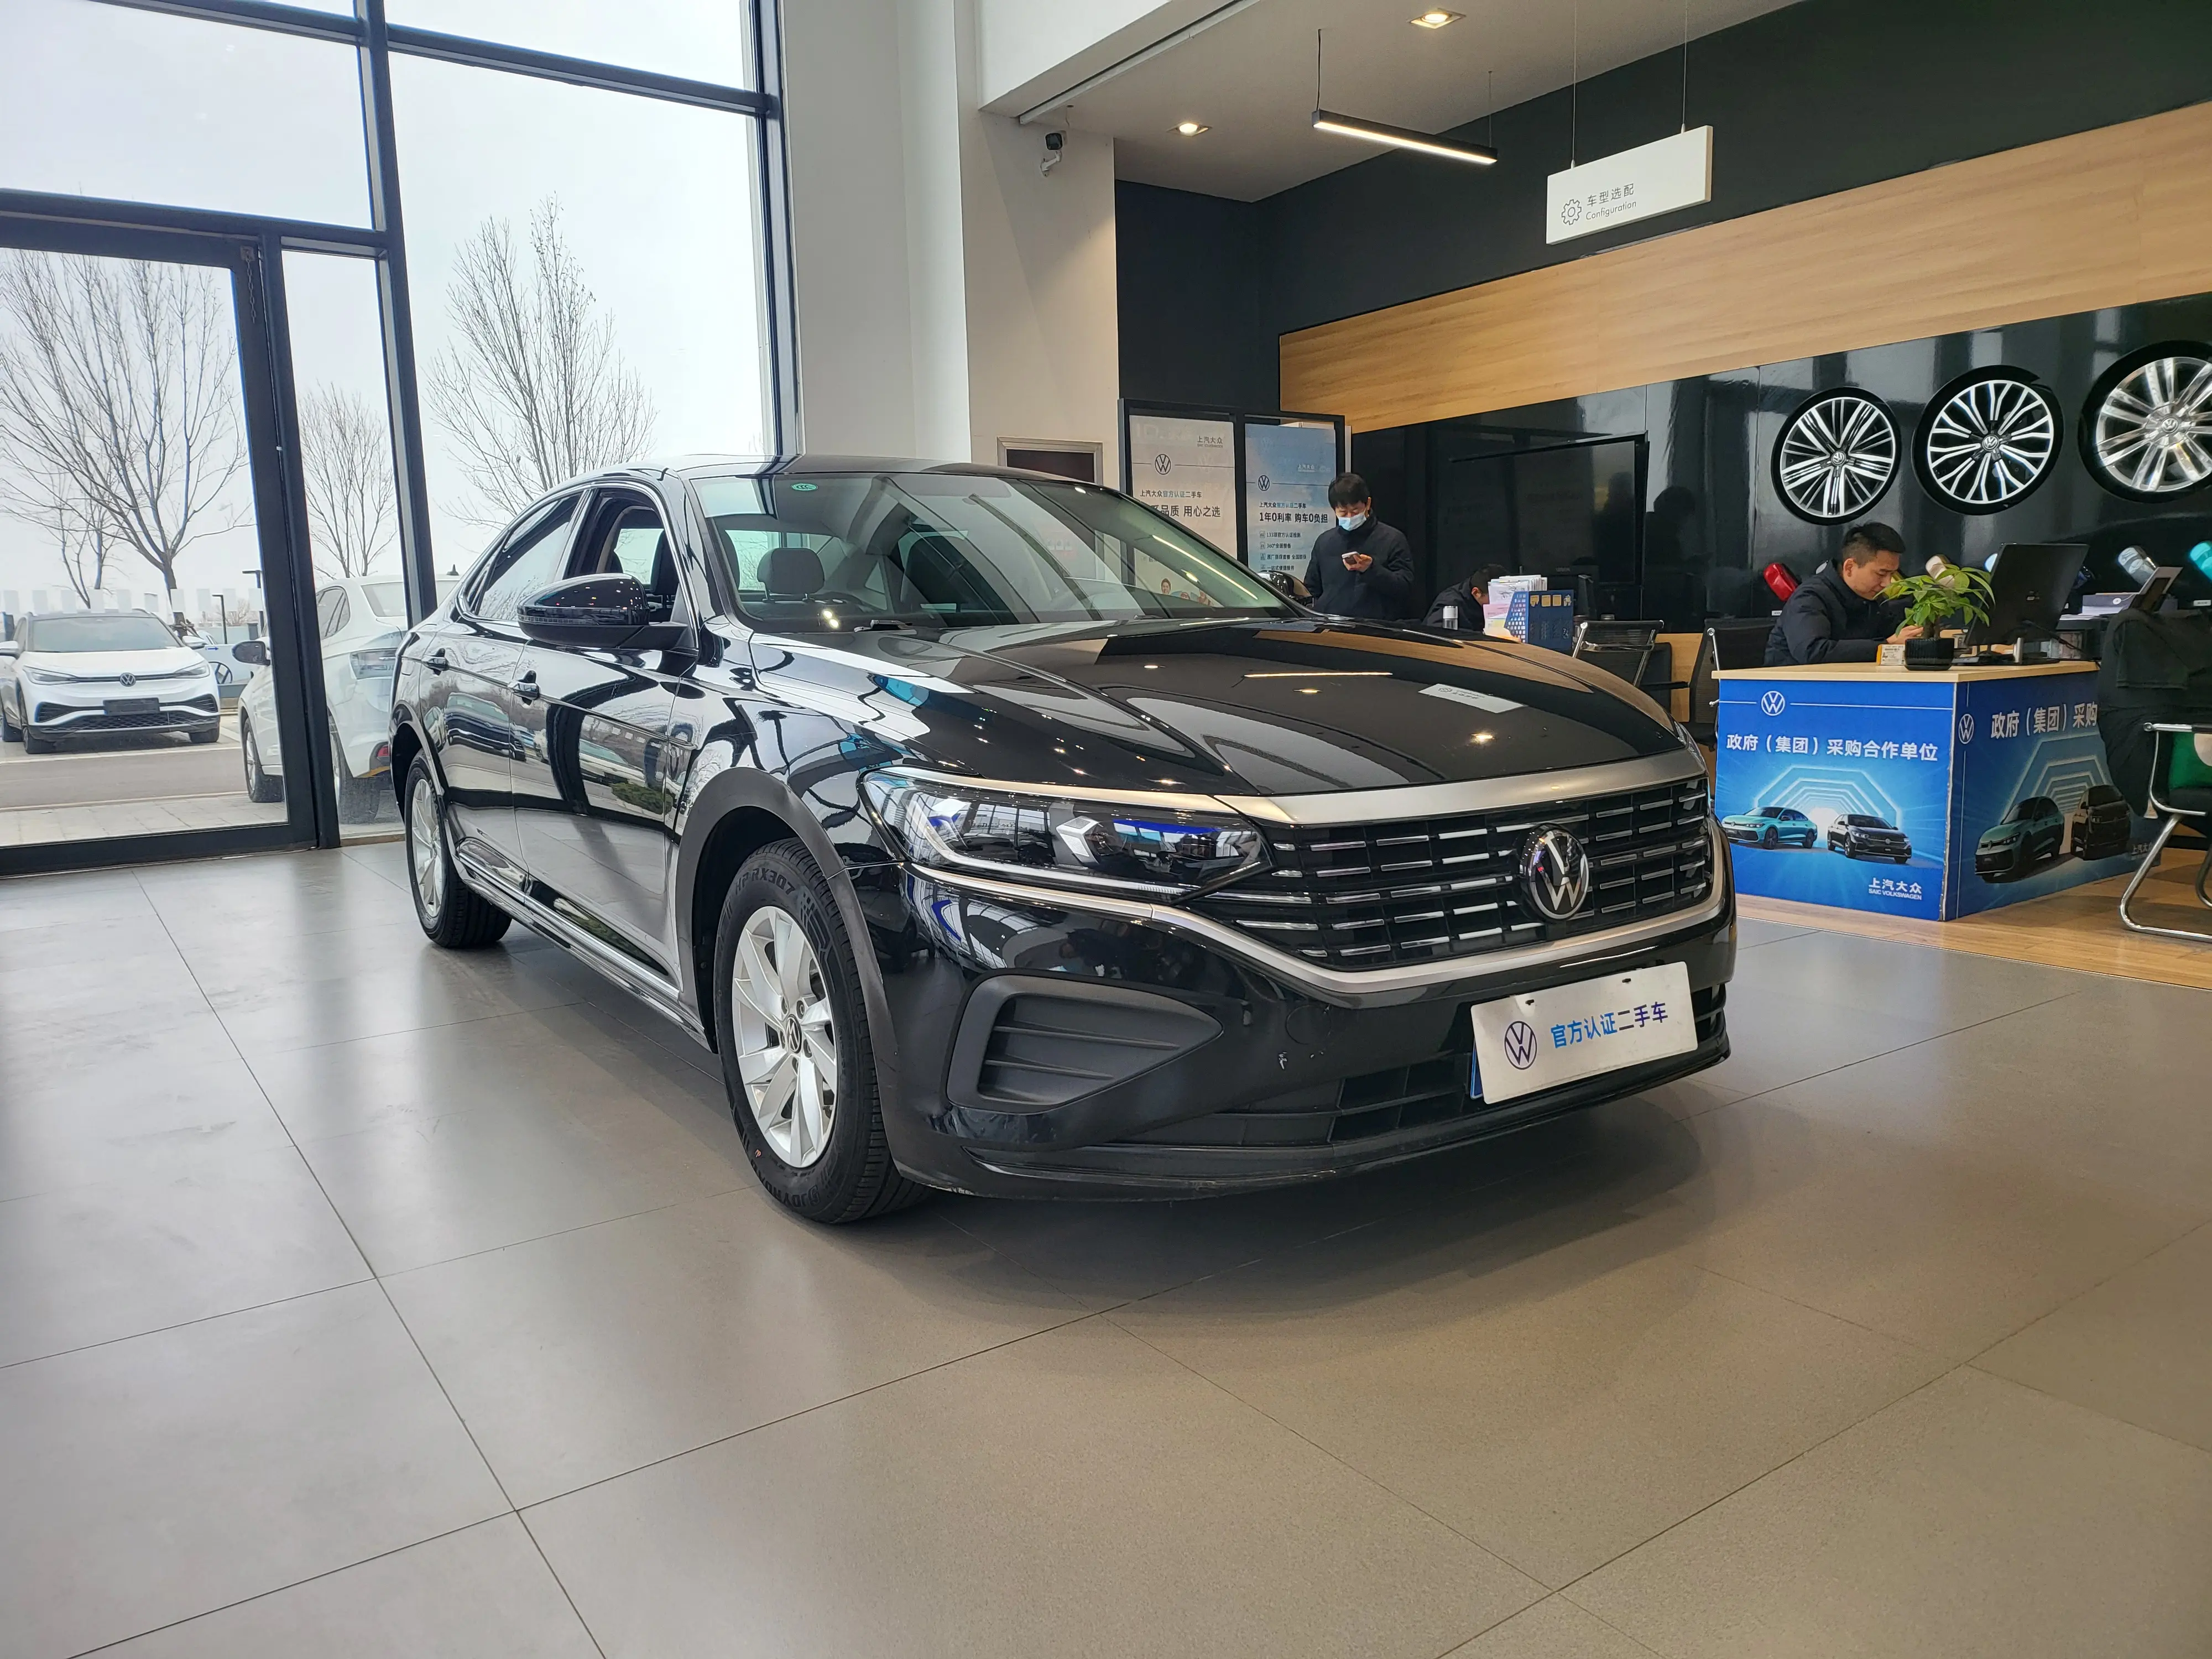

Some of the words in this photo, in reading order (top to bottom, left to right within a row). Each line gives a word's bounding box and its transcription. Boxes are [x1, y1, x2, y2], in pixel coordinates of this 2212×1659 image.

[1587, 183, 1634, 207] 车型选配
[1586, 200, 1637, 220] Configuration
[1197, 435, 1223, 444] 上汽大众
[1140, 489, 1202, 498] 上汽大众官方认证二手车
[1184, 505, 1221, 518] 用心之选
[1259, 512, 1292, 523] 1年0利率
[1295, 513, 1328, 524] 购车0负担
[1726, 733, 1938, 761] 政府（集团）采购合作单位
[752, 868, 796, 895] RX307
[1869, 877, 1922, 894] 上汽大众
[1882, 890, 1922, 901] VOLKSWAGEN
[1550, 1001, 1668, 1049] 官方认证二手车
